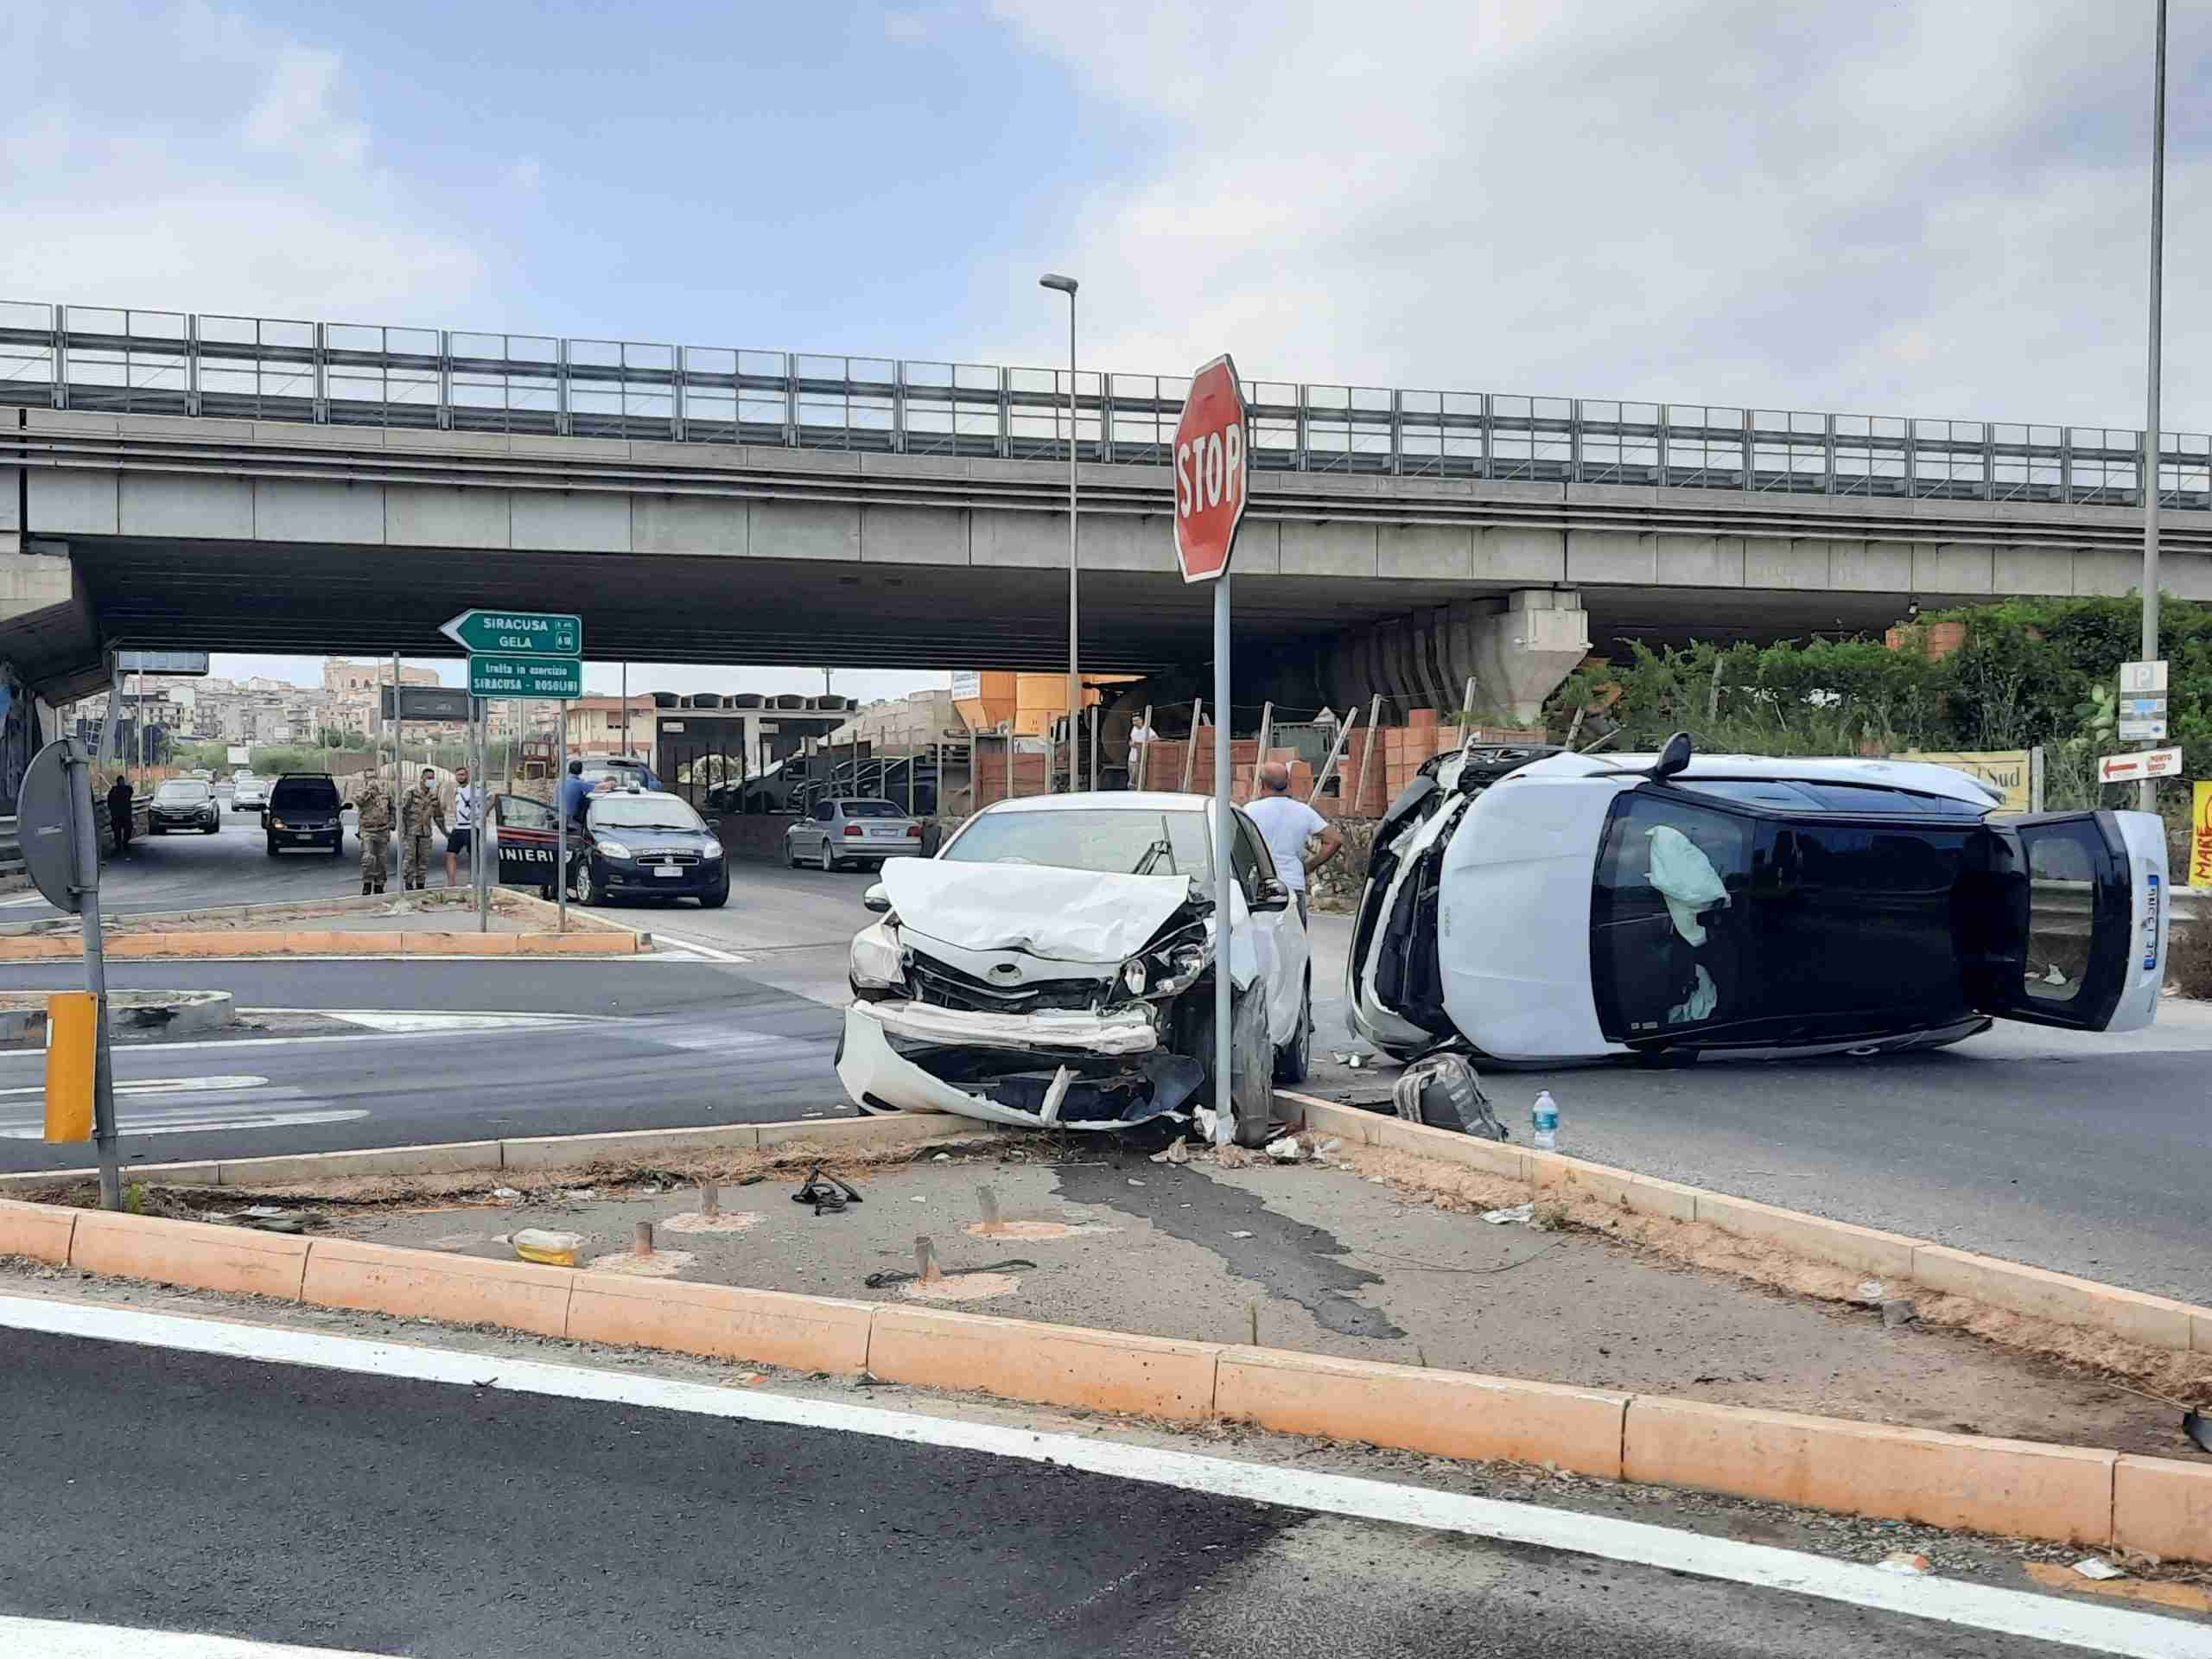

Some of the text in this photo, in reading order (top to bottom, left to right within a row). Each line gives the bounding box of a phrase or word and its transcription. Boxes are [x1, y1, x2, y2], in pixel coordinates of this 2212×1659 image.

[1178, 423, 1240, 518] STOP
[483, 618, 549, 632] SIRACUSA
[499, 636, 532, 648] GELA
[517, 664, 526, 675] in
[474, 678, 522, 690] SIRACUSA
[535, 680, 578, 691] ROSOLINI
[1989, 766, 2018, 786] Sud
